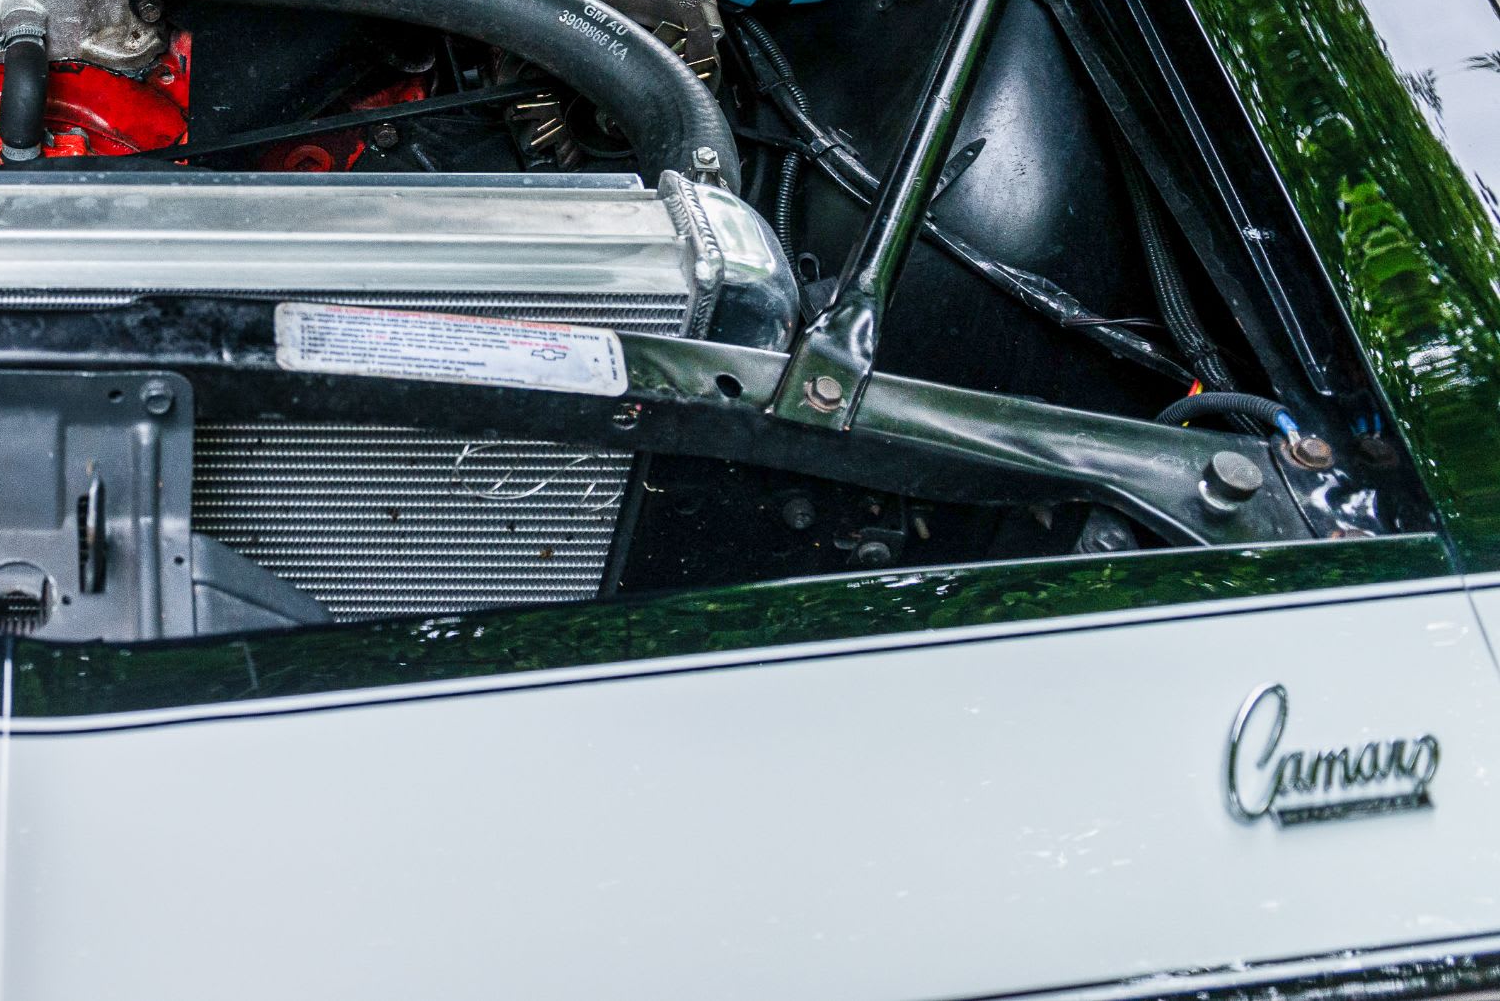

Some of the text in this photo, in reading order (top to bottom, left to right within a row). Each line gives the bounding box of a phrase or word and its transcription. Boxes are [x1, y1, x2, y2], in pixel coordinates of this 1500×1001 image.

[583, 5, 629, 36] GM AU
[607, 39, 629, 61] KA
[1228, 683, 1441, 820] Camaro
